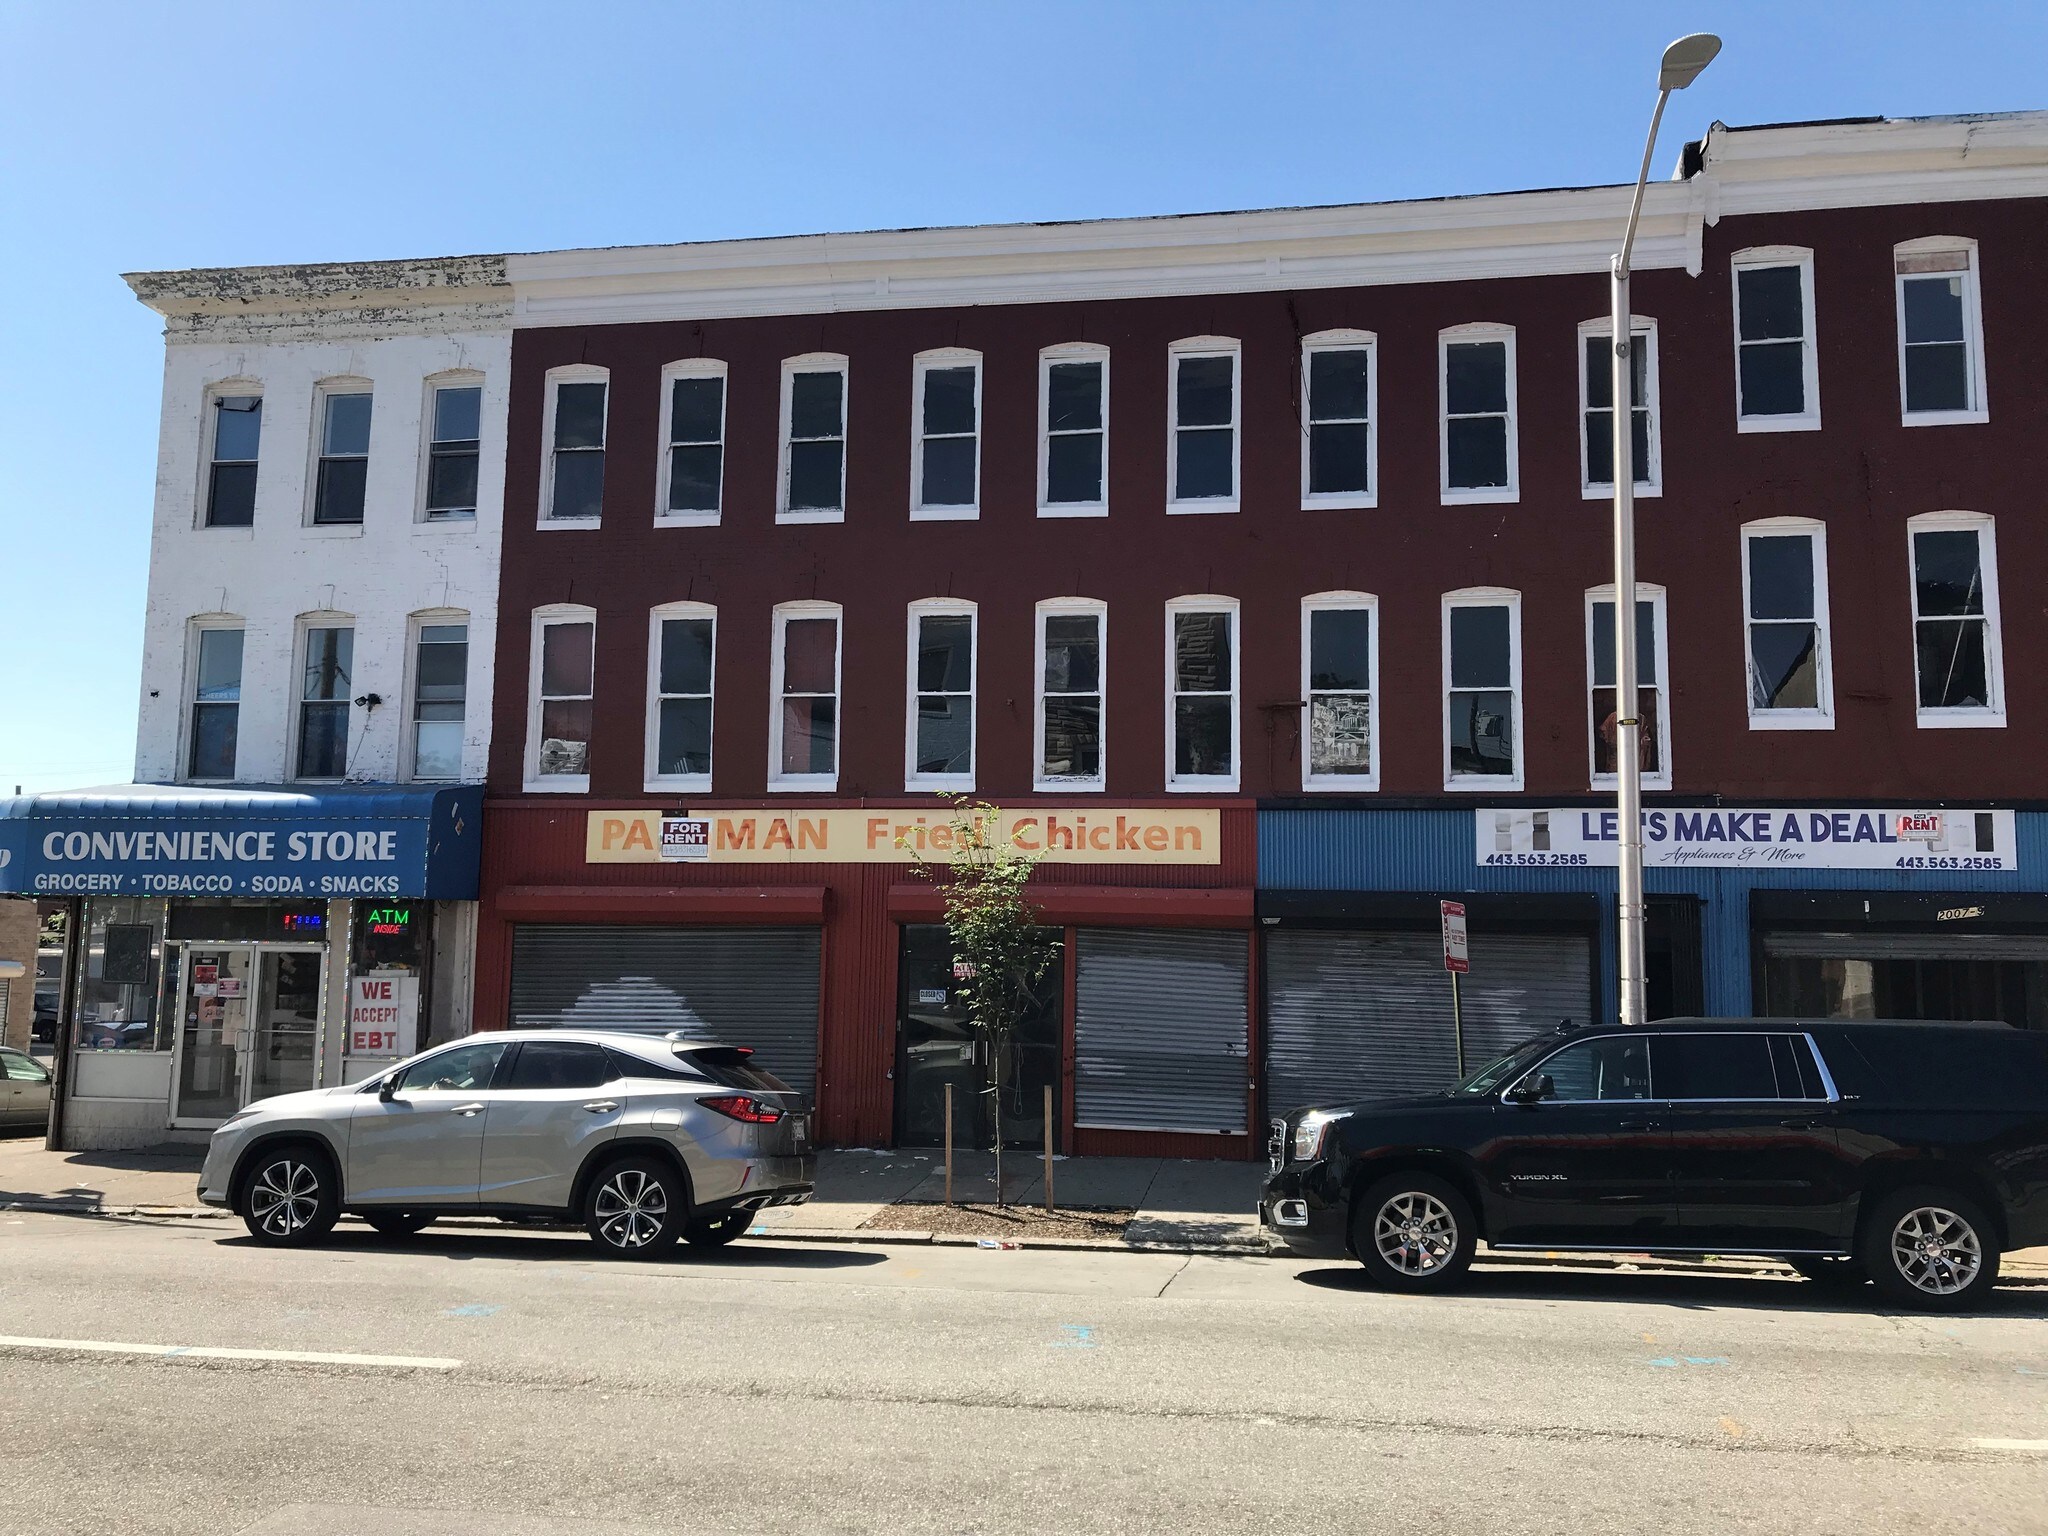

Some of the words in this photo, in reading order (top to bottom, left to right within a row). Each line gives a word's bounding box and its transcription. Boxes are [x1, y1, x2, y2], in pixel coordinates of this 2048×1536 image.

[669, 823, 702, 834] FOR
[1582, 812, 1668, 842] LE'S
[1674, 812, 1772, 842] MAKE
[1779, 813, 1804, 843] A
[1810, 813, 1898, 843] DEAL
[1902, 816, 1938, 831] RENT
[602, 819, 654, 850] PA
[716, 818, 829, 850] MAN
[1010, 815, 1203, 851] Chicken
[663, 833, 707, 844] RENT
[42, 831, 276, 861] CONVENIENCE
[287, 831, 397, 862] STORE
[1486, 854, 1588, 866] 443.563.2585
[1660, 846, 1735, 864] Appliances
[1761, 846, 1806, 862] More
[1896, 856, 2002, 870] 443.563.2585
[34, 873, 124, 890] GROCERY
[142, 874, 233, 892] TOBACCO
[251, 875, 304, 893] SODA
[320, 875, 400, 893] SNACKS
[368, 909, 409, 925] ATM
[372, 924, 402, 934] INSIDE
[361, 982, 392, 1000] WE
[353, 1007, 398, 1023] ACCEPT
[353, 1031, 397, 1049] EBT
